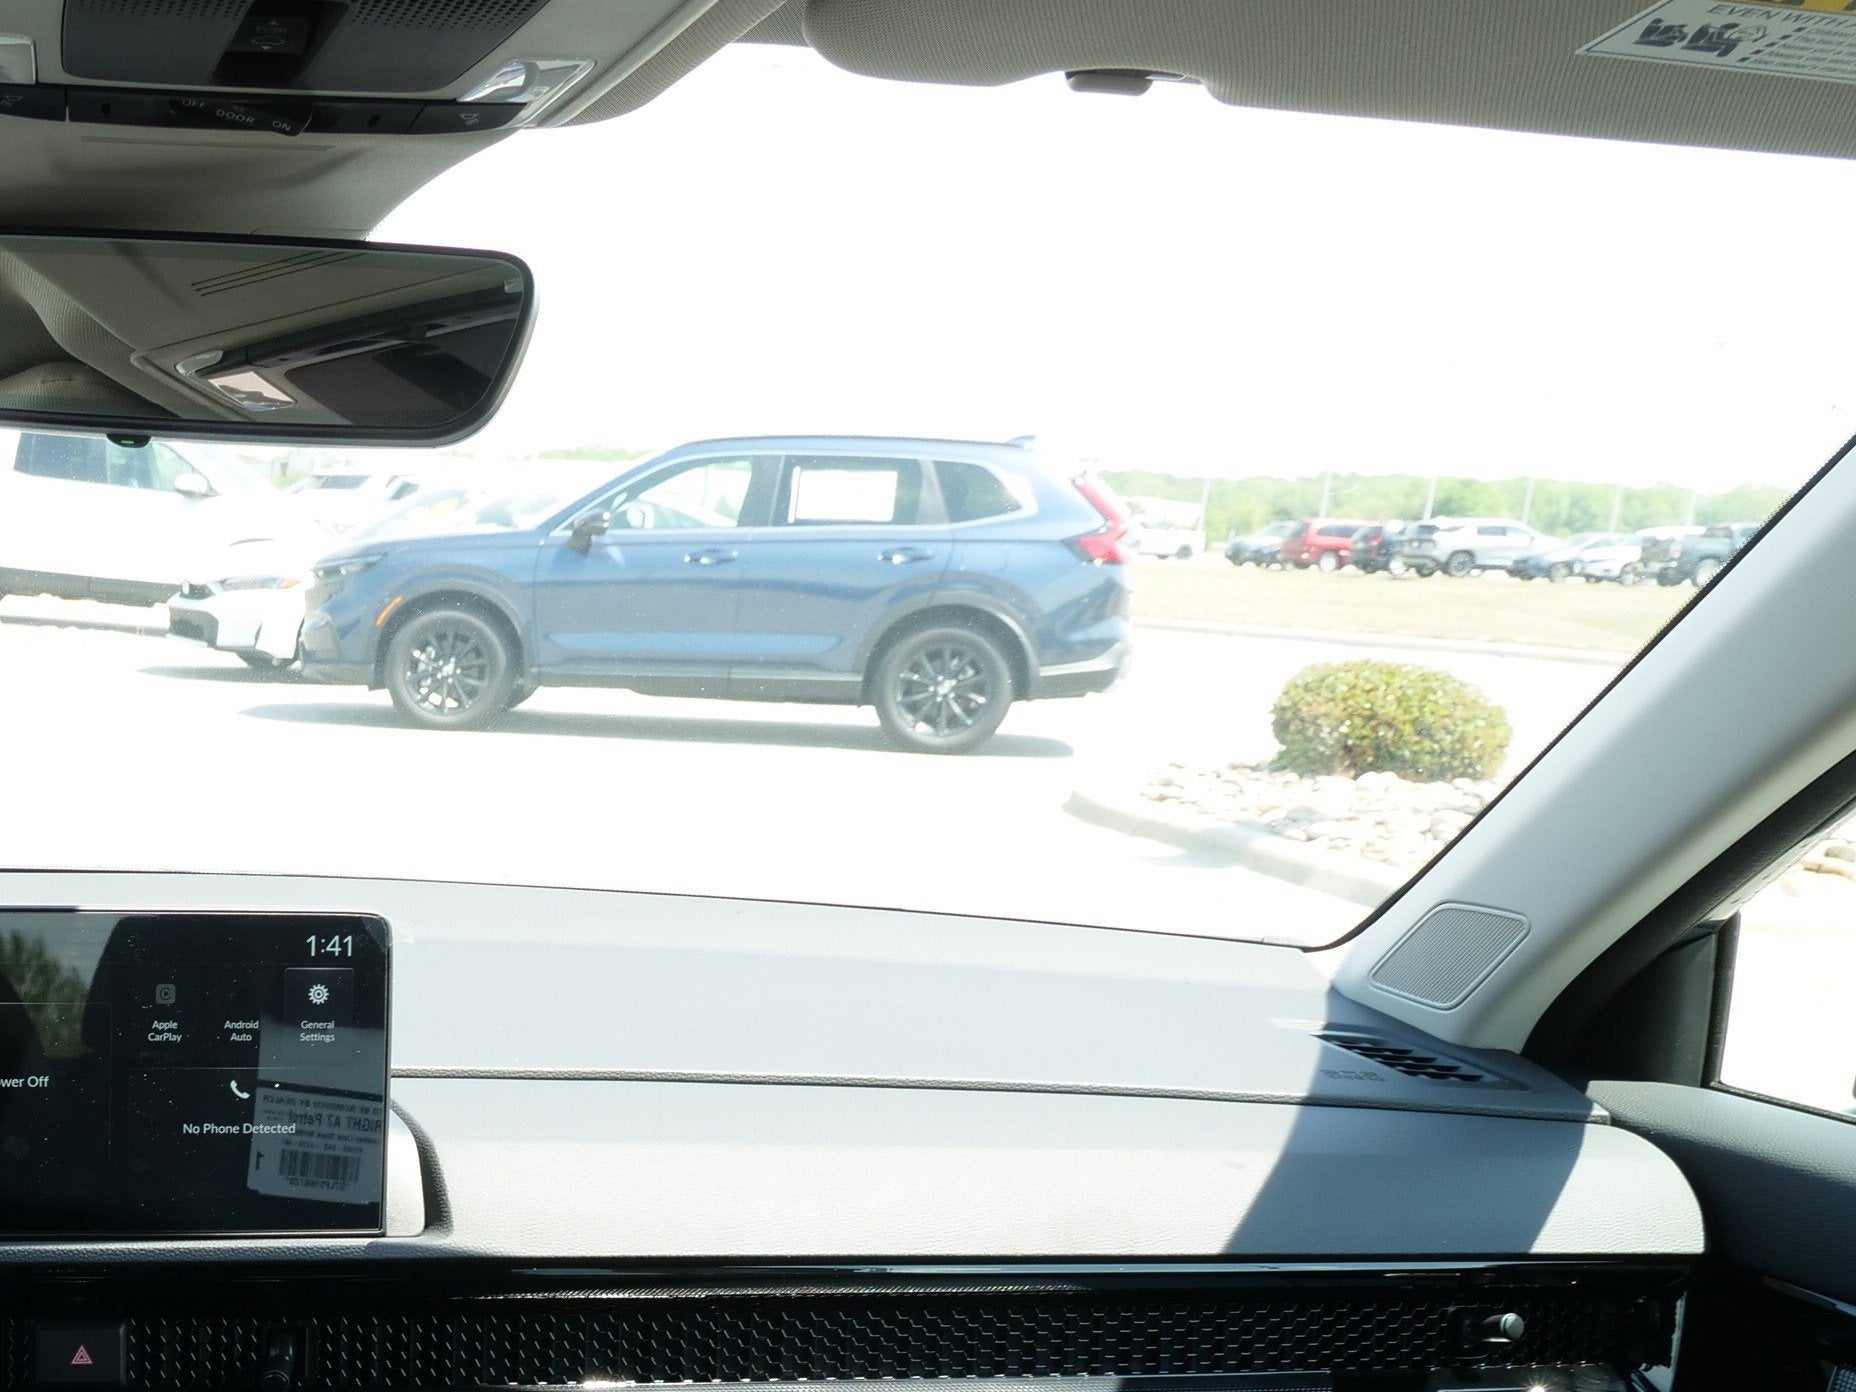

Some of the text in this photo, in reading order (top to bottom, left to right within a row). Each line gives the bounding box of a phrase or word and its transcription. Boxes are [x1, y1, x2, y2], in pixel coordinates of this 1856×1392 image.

[1707, 4, 1849, 27] EVEN WITH
[216, 108, 255, 124] DOOR
[272, 120, 292, 131] ON
[306, 935, 354, 957] 1:41
[152, 1020, 178, 1031] Apple
[224, 1020, 259, 1029] Android
[301, 1020, 335, 1029] General
[148, 1033, 182, 1043] CarPlay
[230, 1033, 252, 1041] Auto
[300, 1033, 335, 1043] Settings
[27, 1075, 49, 1088] Off
[182, 1123, 296, 1134] No Phone Detected
